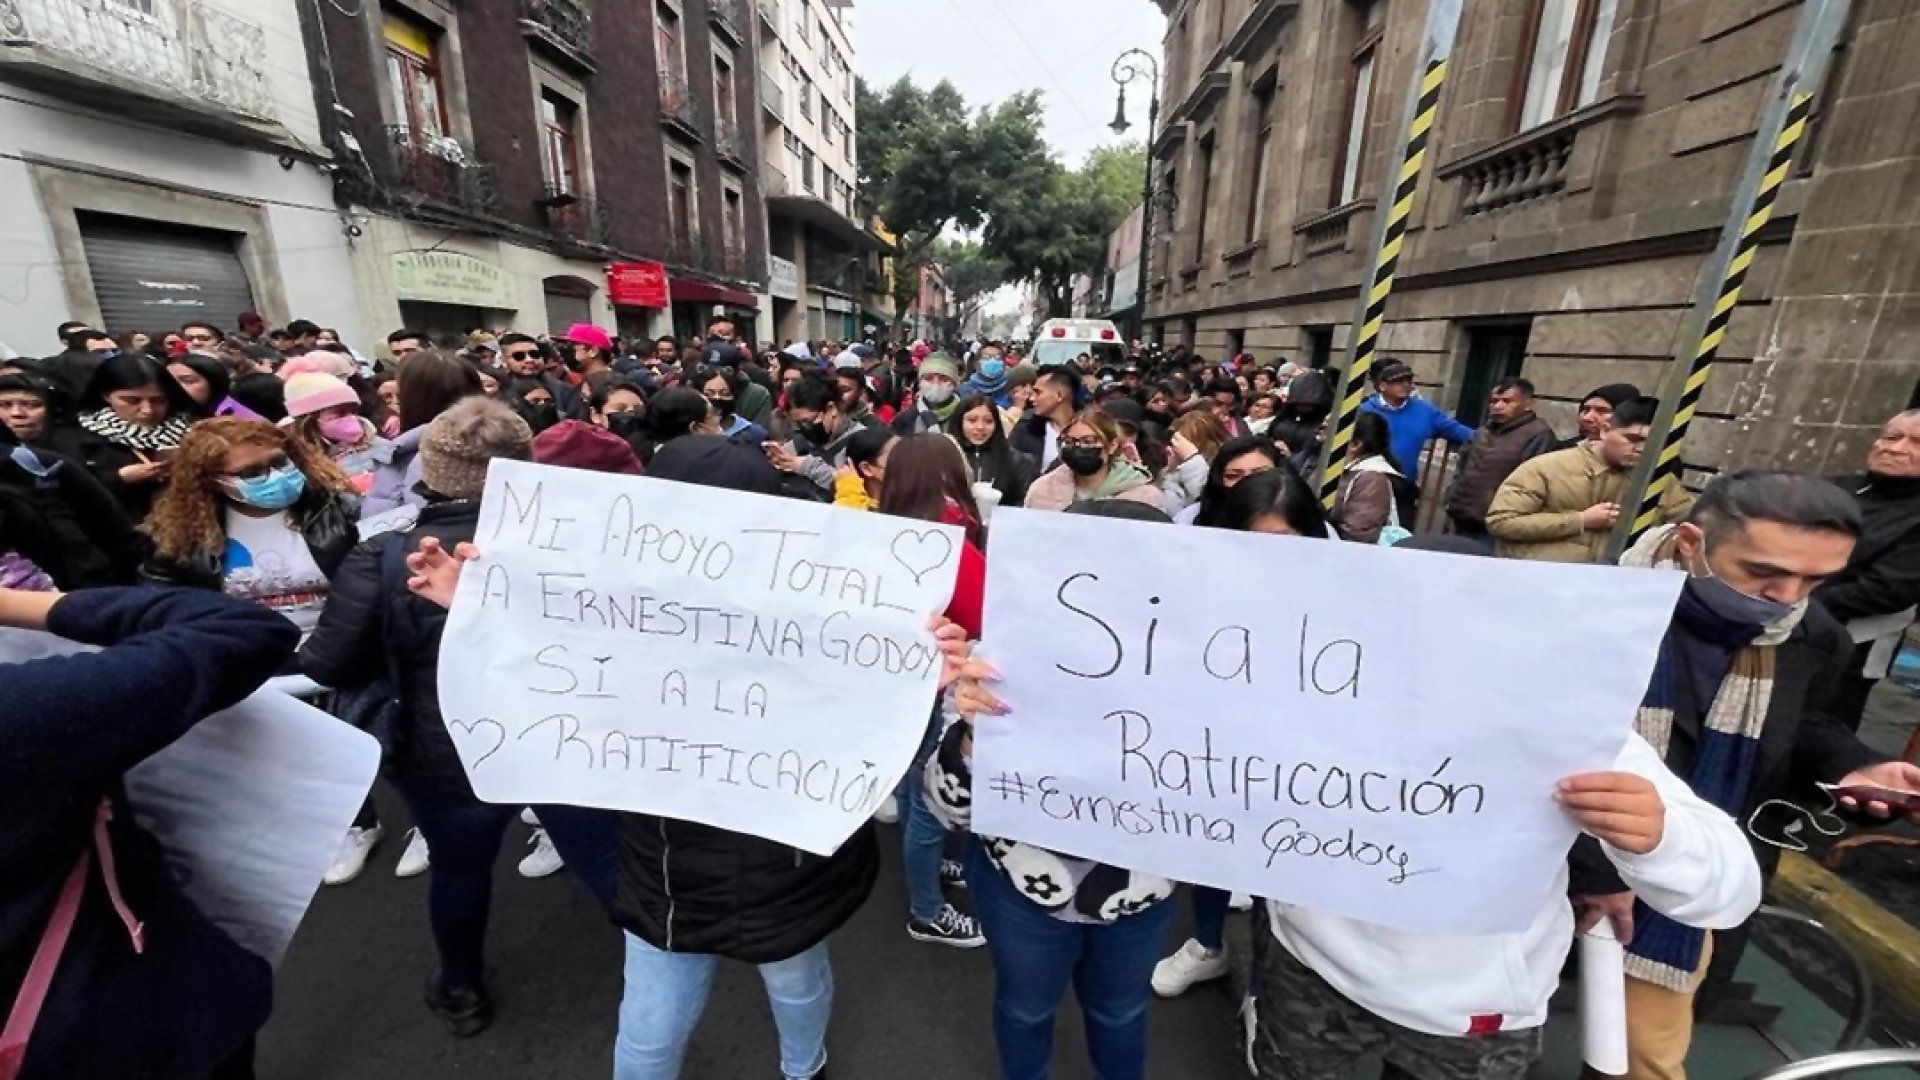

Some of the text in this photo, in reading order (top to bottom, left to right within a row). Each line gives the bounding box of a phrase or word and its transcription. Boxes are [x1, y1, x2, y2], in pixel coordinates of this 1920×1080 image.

[492, 480, 915, 613] MI APOYO TOTAL
[481, 564, 939, 680] A ERNESTINA GODOY
[1055, 571, 1362, 698] Si a la
[661, 669, 687, 707] A
[714, 680, 767, 718] LA
[517, 712, 892, 813] RATIFICACIÓN
[1102, 709, 1485, 816] Ratificación
[989, 771, 1440, 884] #Ernestina Godoy
